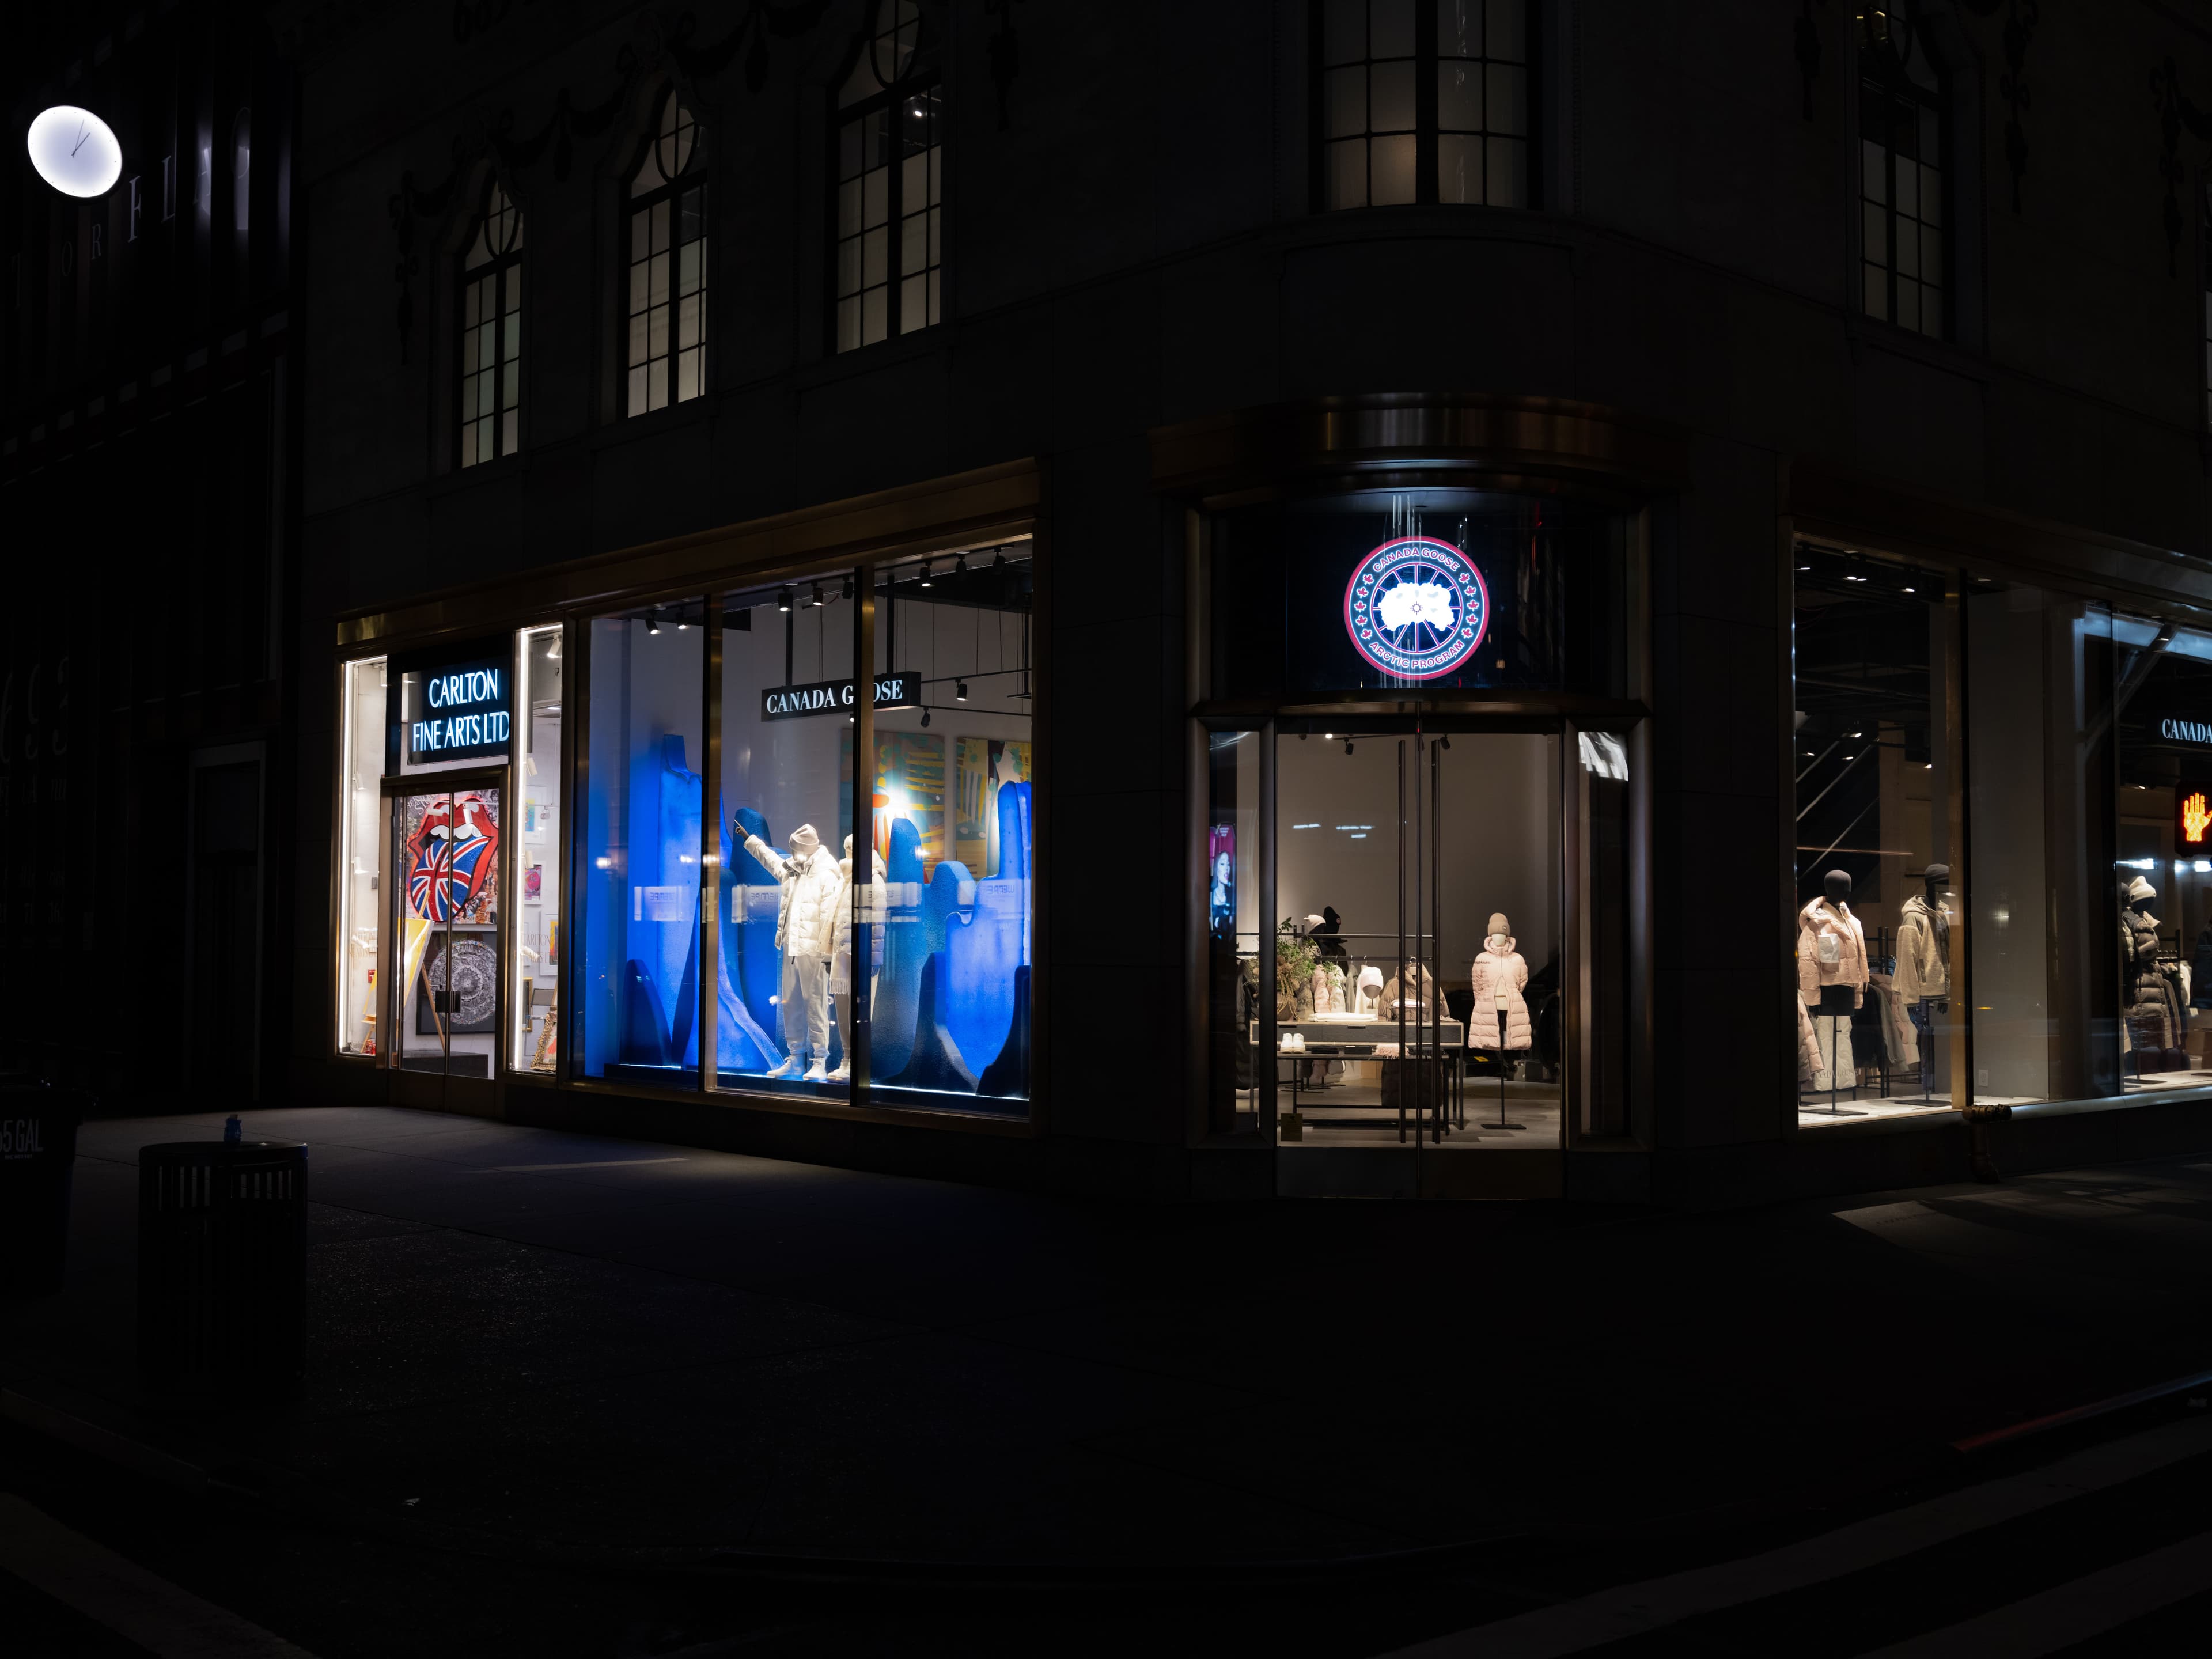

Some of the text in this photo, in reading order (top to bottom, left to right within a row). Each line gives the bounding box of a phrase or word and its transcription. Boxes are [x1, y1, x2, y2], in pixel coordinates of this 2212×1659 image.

[1373, 547, 1460, 572] CANADA GOOSE
[1369, 640, 1464, 669] ARCTIC PROGRAM
[429, 668, 498, 709] CARLTON
[766, 687, 836, 714] CANADA
[413, 711, 510, 752] FINE ARTS LTD
[16, 1118, 44, 1152] GAL
